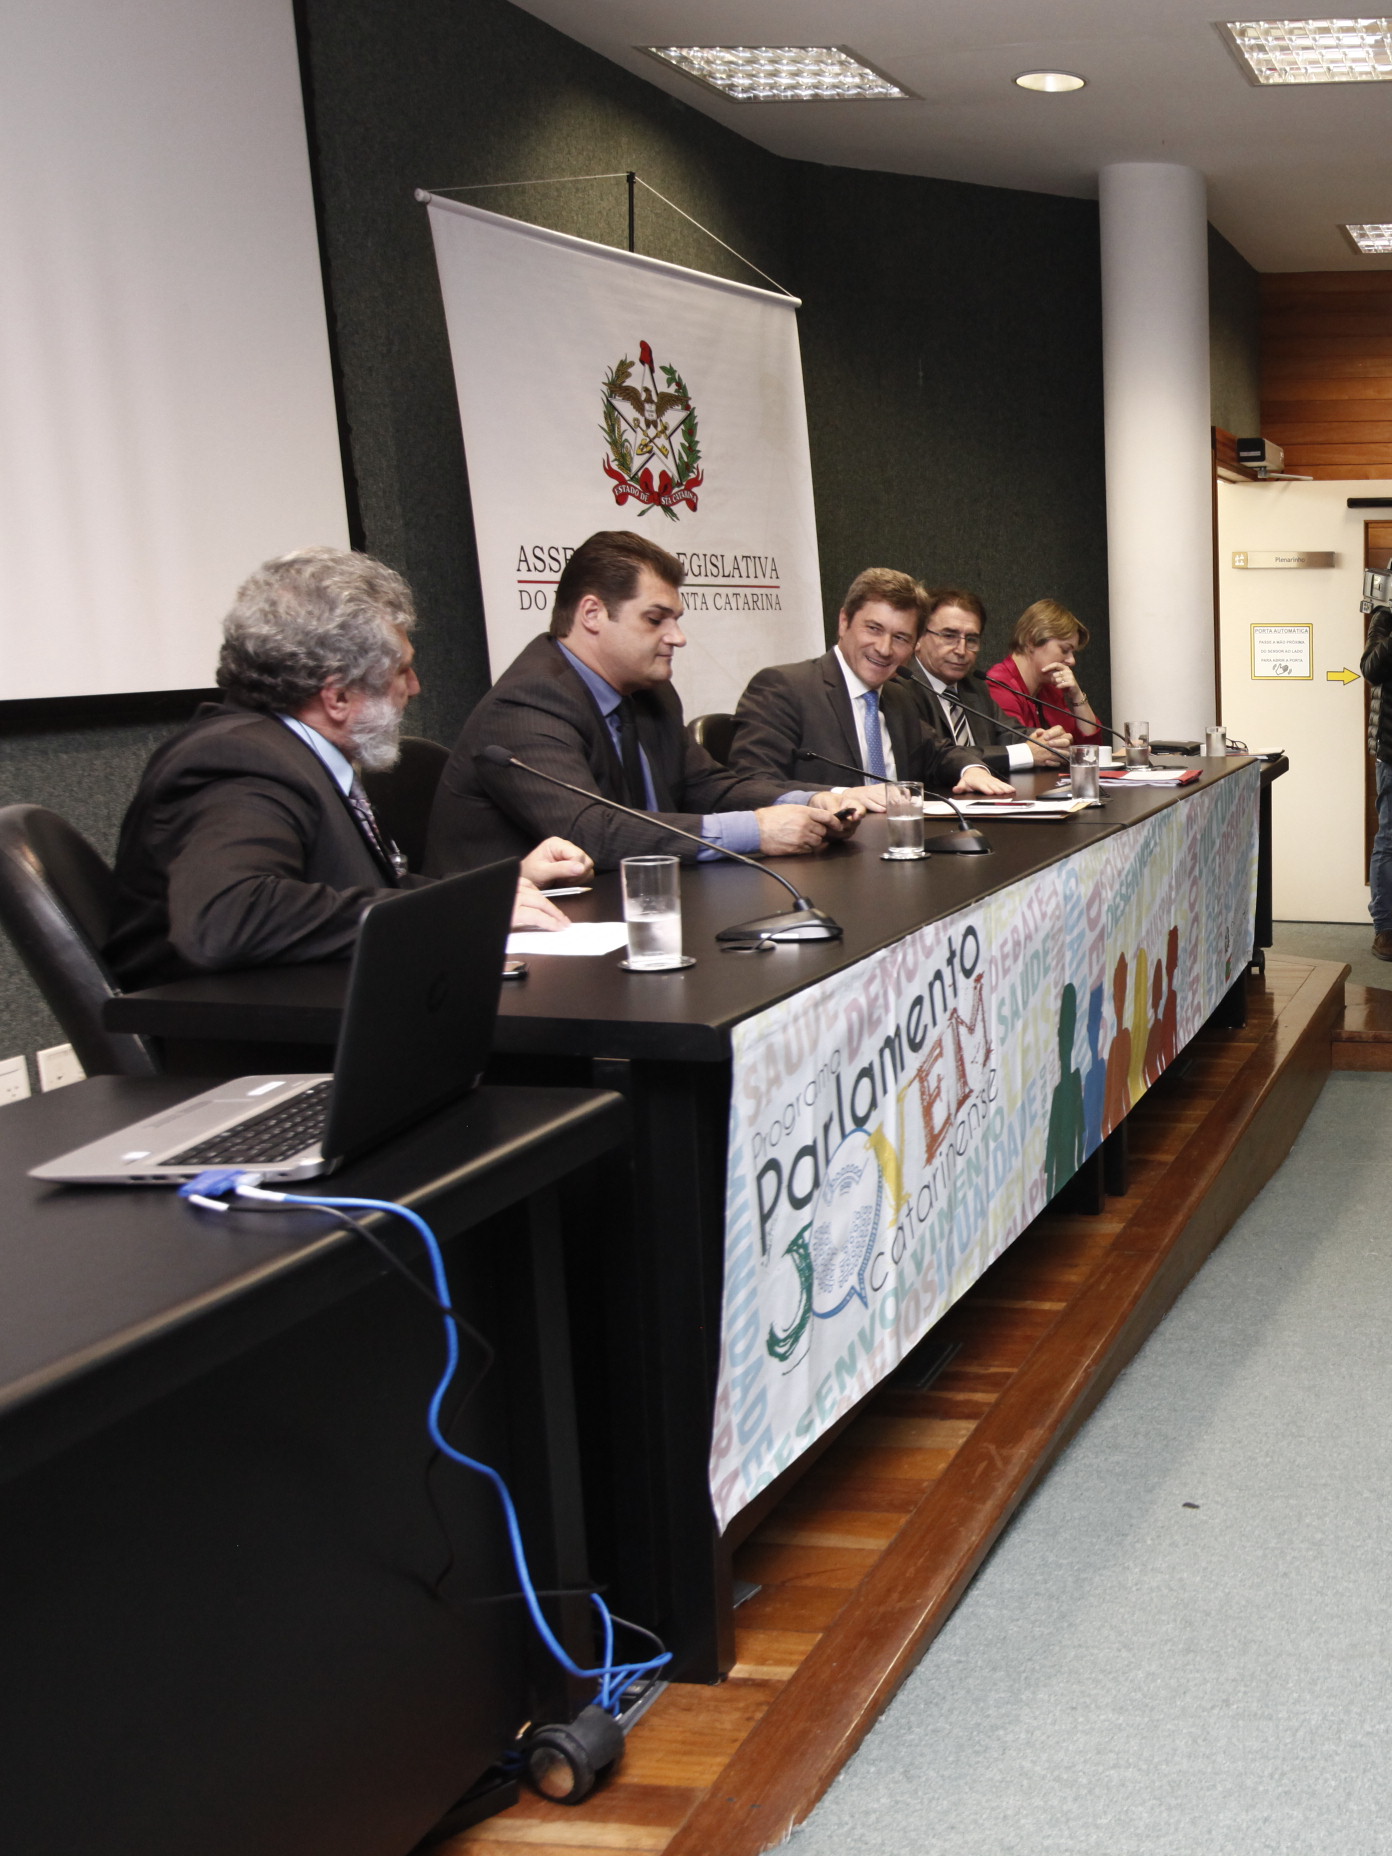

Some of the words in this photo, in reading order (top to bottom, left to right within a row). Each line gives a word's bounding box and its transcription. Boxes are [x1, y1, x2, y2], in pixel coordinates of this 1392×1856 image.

[615, 484, 640, 497] ESTADO
[639, 490, 649, 503] DE
[676, 552, 780, 580] EGISLATIVA
[1274, 556, 1306, 564] Plenarinho
[518, 589, 547, 611] DO
[713, 592, 782, 611] CATARINA
[756, 925, 981, 1257] Parlamento
[752, 1049, 842, 1171] Programa
[869, 1068, 998, 1292] catarinense
